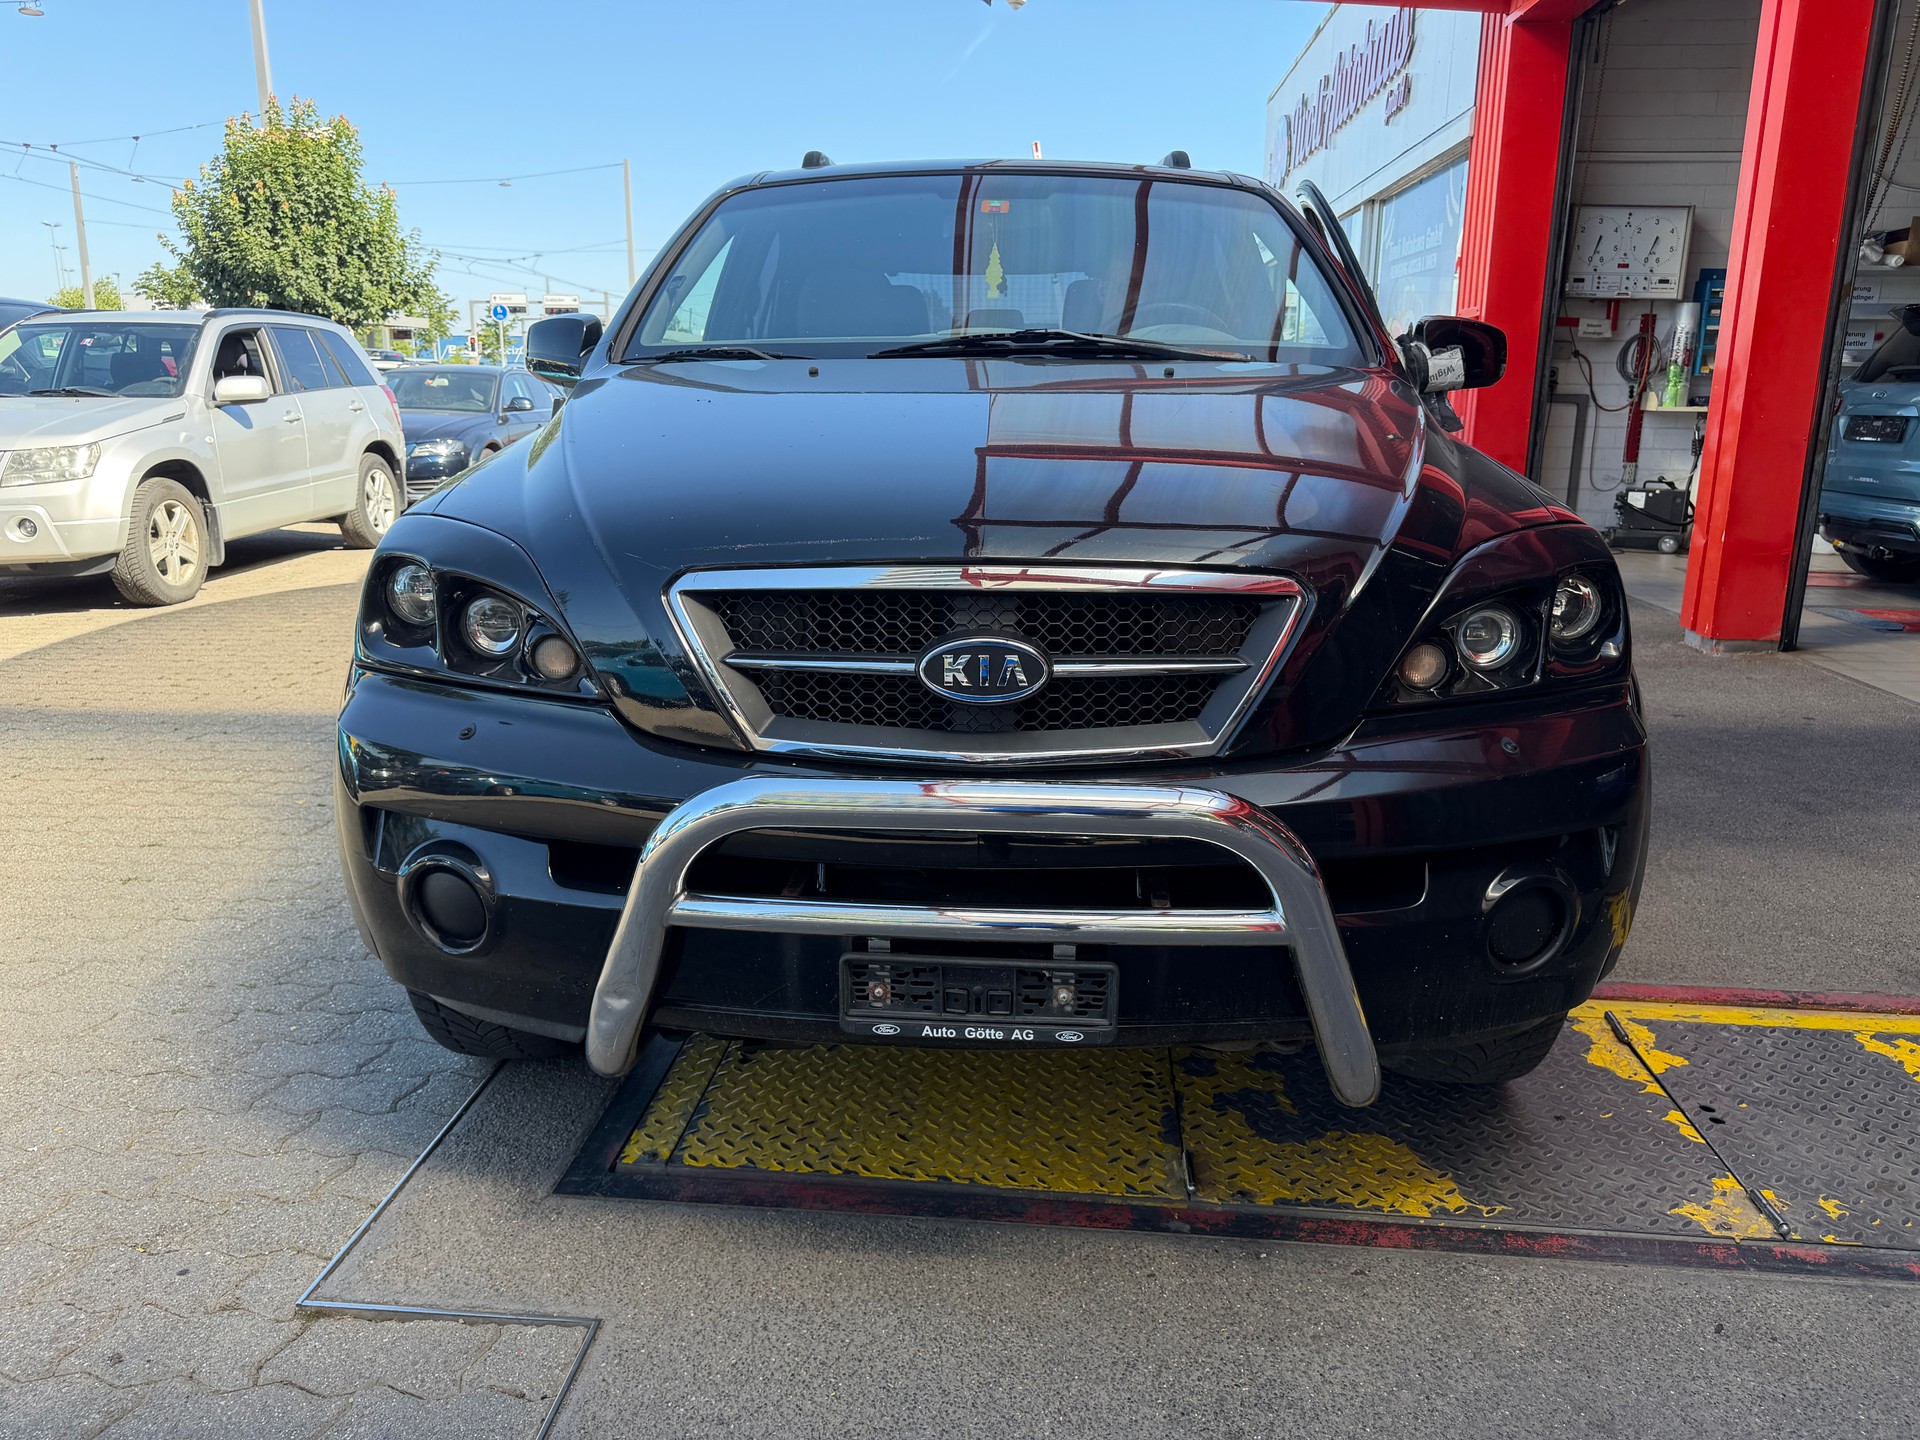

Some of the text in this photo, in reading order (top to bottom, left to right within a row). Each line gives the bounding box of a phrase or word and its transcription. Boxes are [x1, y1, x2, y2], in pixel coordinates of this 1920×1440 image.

[942, 655, 1028, 686] KIA
[875, 1025, 897, 1034] Ford
[922, 1025, 1034, 1040] Auto Götte AG
[1059, 1032, 1081, 1041] Ford
